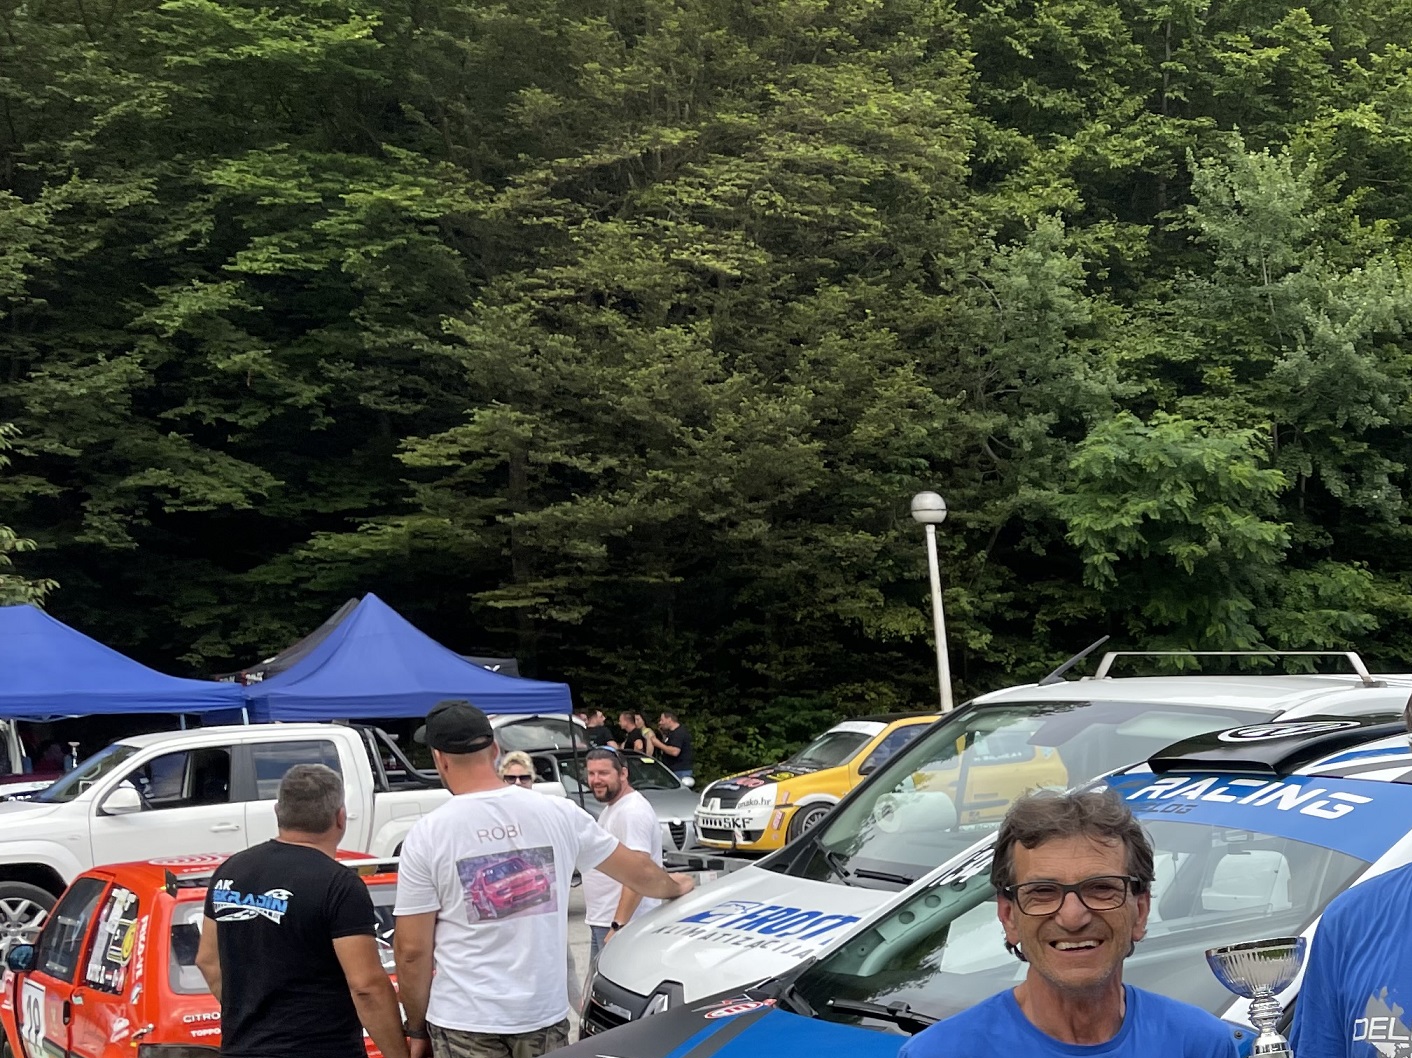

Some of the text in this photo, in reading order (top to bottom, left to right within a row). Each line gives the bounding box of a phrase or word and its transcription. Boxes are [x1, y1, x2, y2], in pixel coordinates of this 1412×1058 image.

[1125, 777, 1374, 819] RACING
[722, 817, 753, 829] SKF
[476, 823, 523, 844] ROBI
[214, 879, 234, 890] AK
[717, 905, 863, 941] FROST
[651, 924, 815, 959] KLIMATIZACIJA
[183, 1011, 220, 1023] CITRO
[190, 1028, 221, 1038] TOPPO
